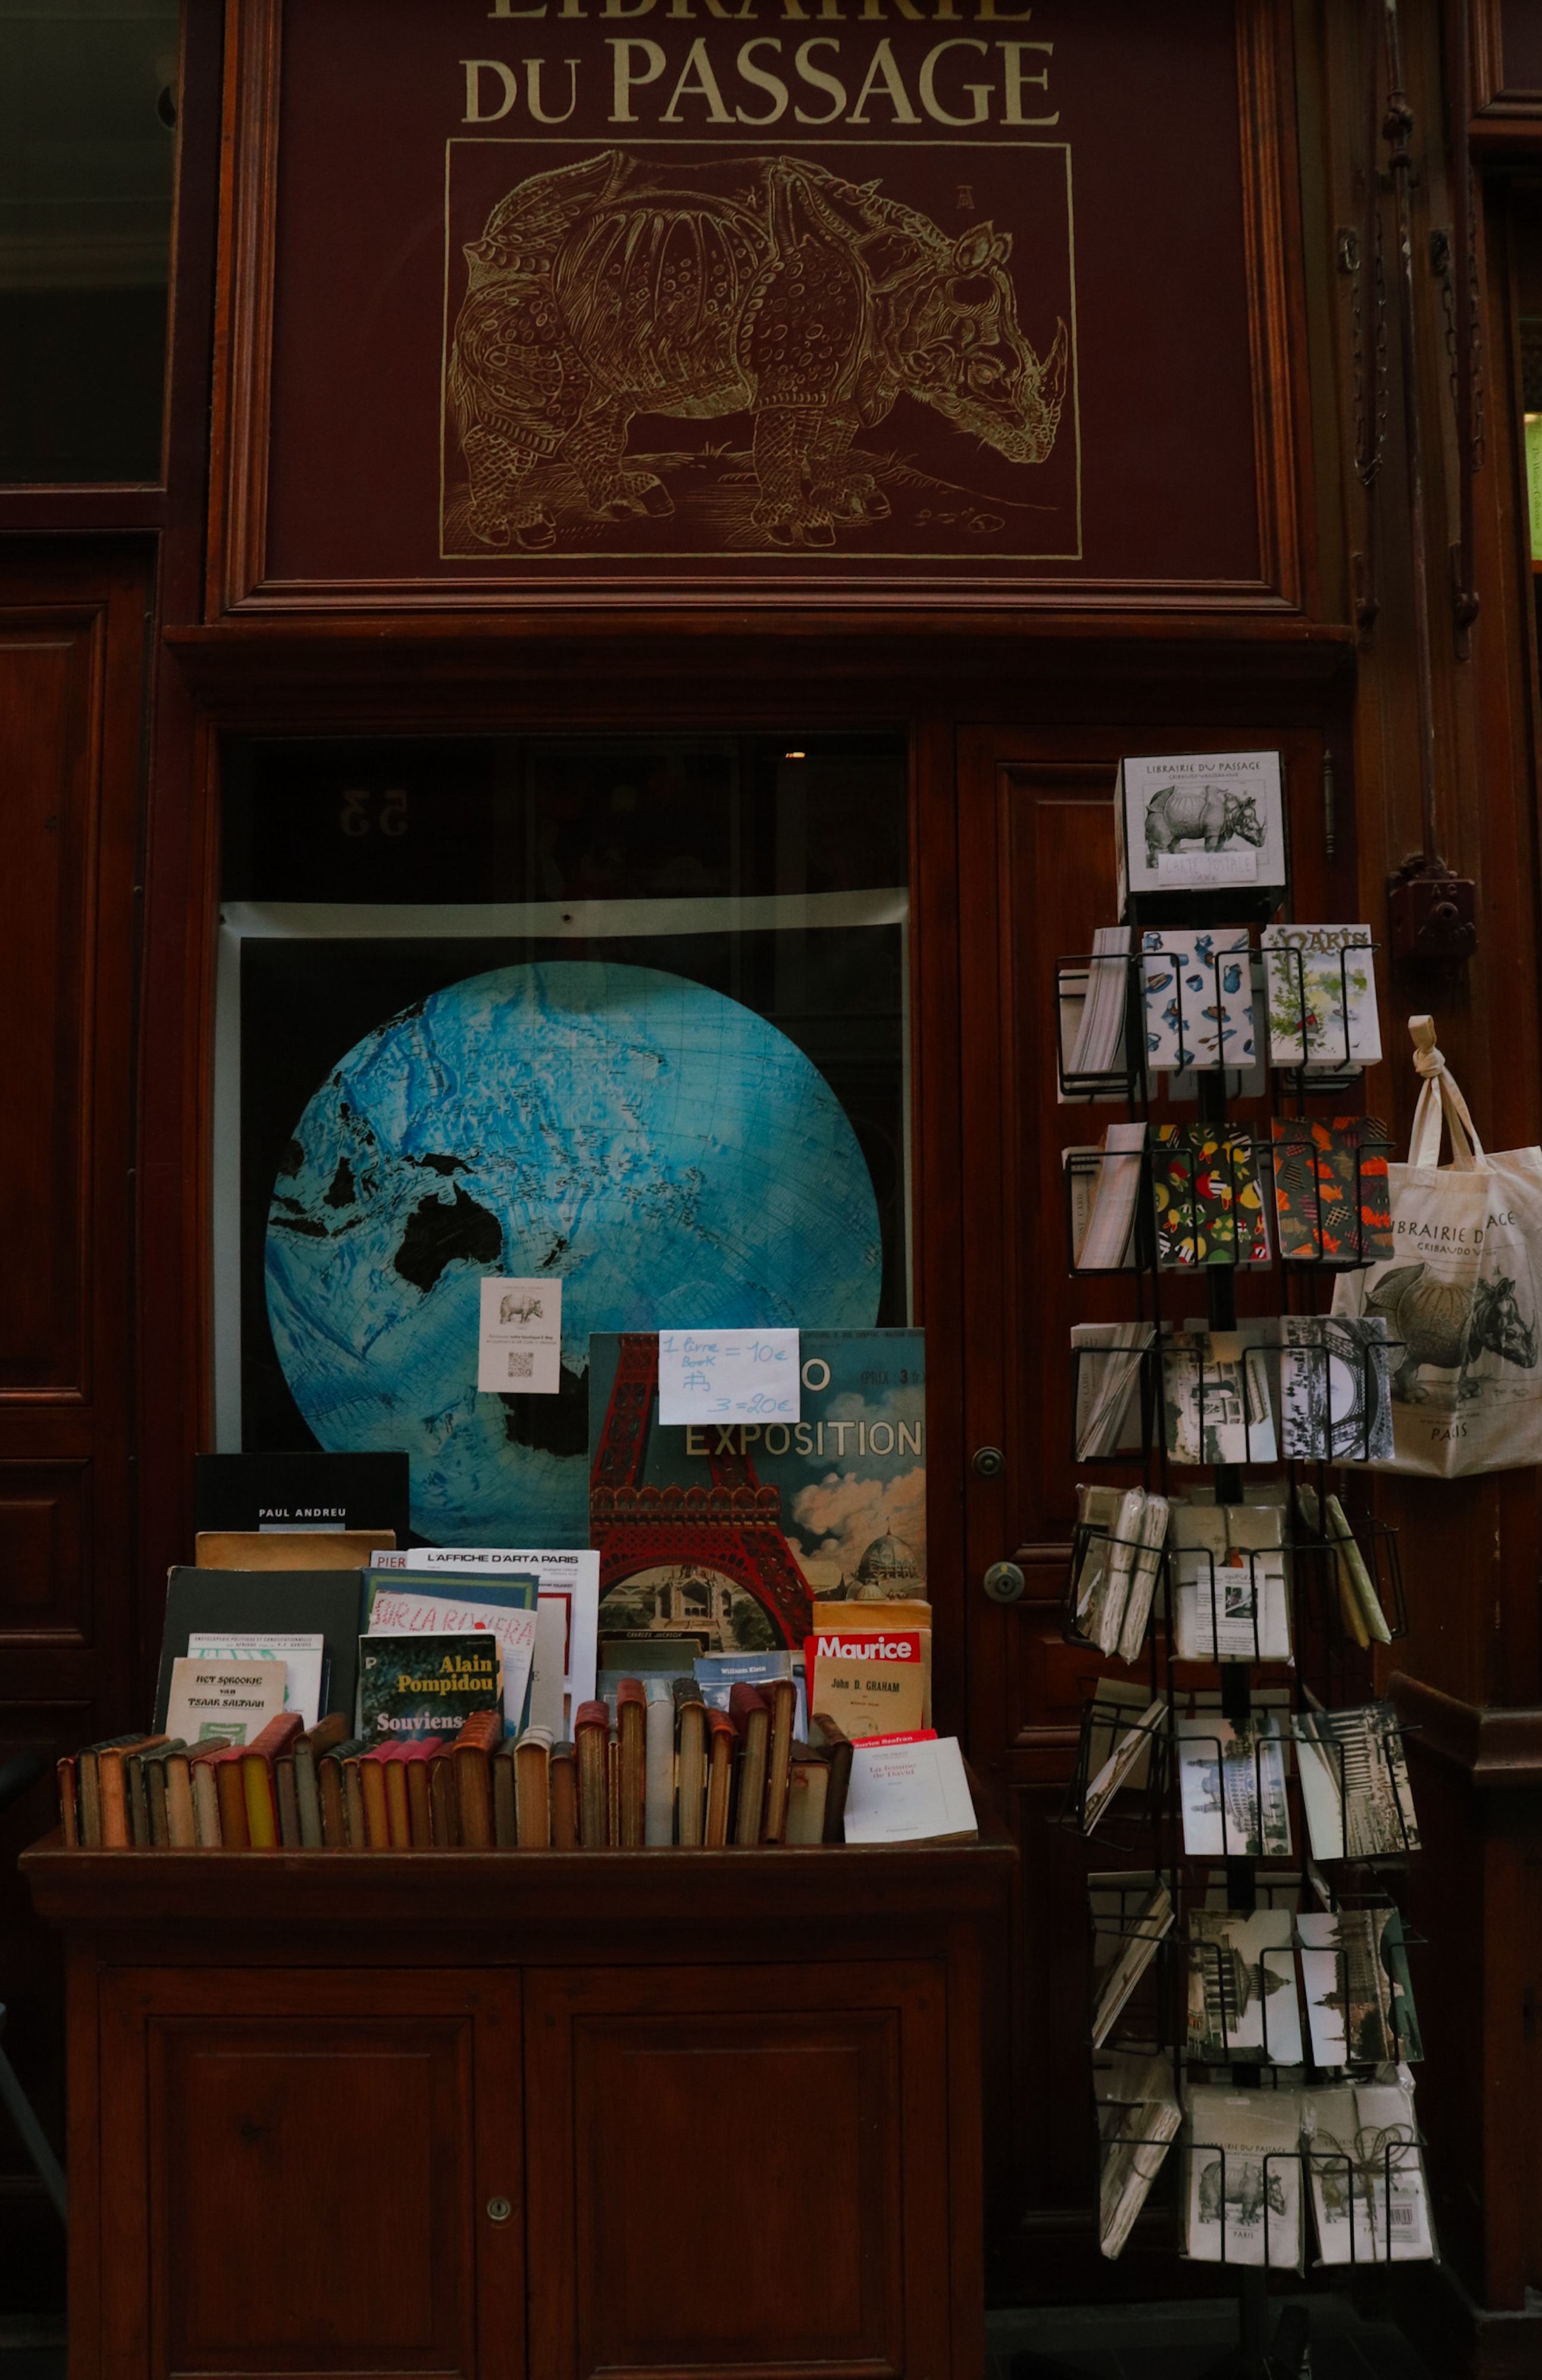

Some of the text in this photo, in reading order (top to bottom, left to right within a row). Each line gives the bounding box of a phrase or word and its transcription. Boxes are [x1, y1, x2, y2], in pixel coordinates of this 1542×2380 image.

[458, 36, 1060, 126] DU PASSAGE
[1146, 761, 1261, 774] LIBRAIRIE DU PASSAGE
[1390, 1220, 1466, 1244] IBRAIRIE
[662, 1336, 680, 1352] 1
[683, 1336, 721, 1354] livre
[746, 1392, 794, 1415] 20€
[686, 1421, 923, 1457] EXPOSITION
[258, 1507, 347, 1518] PAUL ANDREU
[377, 1557, 406, 1568] PIER
[427, 1554, 489, 1562] L'AFFICHE
[492, 1555, 529, 1563] D'ART
[542, 1555, 579, 1564] PARIS
[371, 1598, 533, 1646] SUR LA RIVIERA
[816, 1636, 912, 1660] Maurice
[439, 1654, 493, 1674] Alain
[720, 1667, 749, 1675] William
[196, 1675, 216, 1683] HET
[398, 1673, 493, 1697] Pompidou
[831, 1678, 900, 1693] John D. GRAHAM
[377, 1711, 467, 1731] Souviens-
[881, 1735, 914, 1744] Szafran
[884, 1763, 917, 1772] femme
[887, 1768, 915, 1778] David
